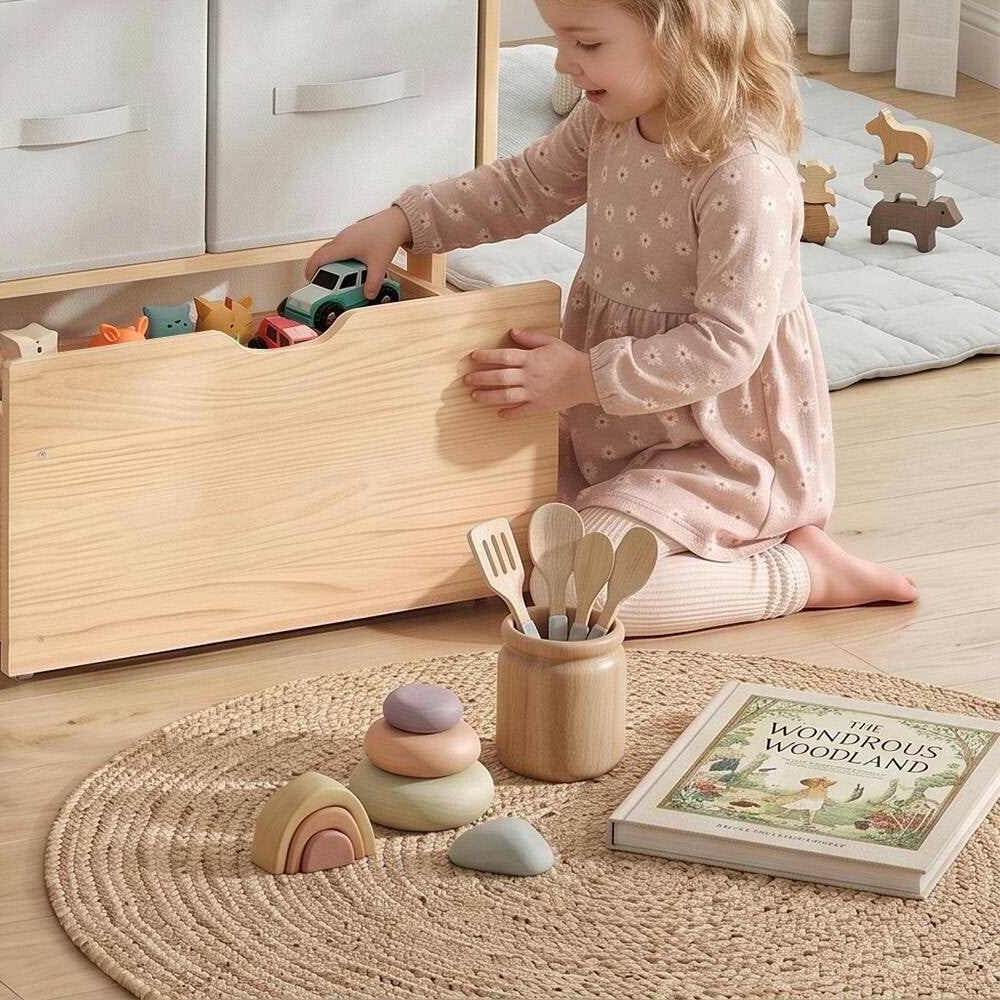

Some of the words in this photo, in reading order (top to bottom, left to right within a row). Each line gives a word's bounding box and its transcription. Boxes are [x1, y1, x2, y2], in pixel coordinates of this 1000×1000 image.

[770, 721, 943, 760] WONDROUS
[850, 720, 885, 734] THE
[764, 738, 930, 774] WOODLAND
